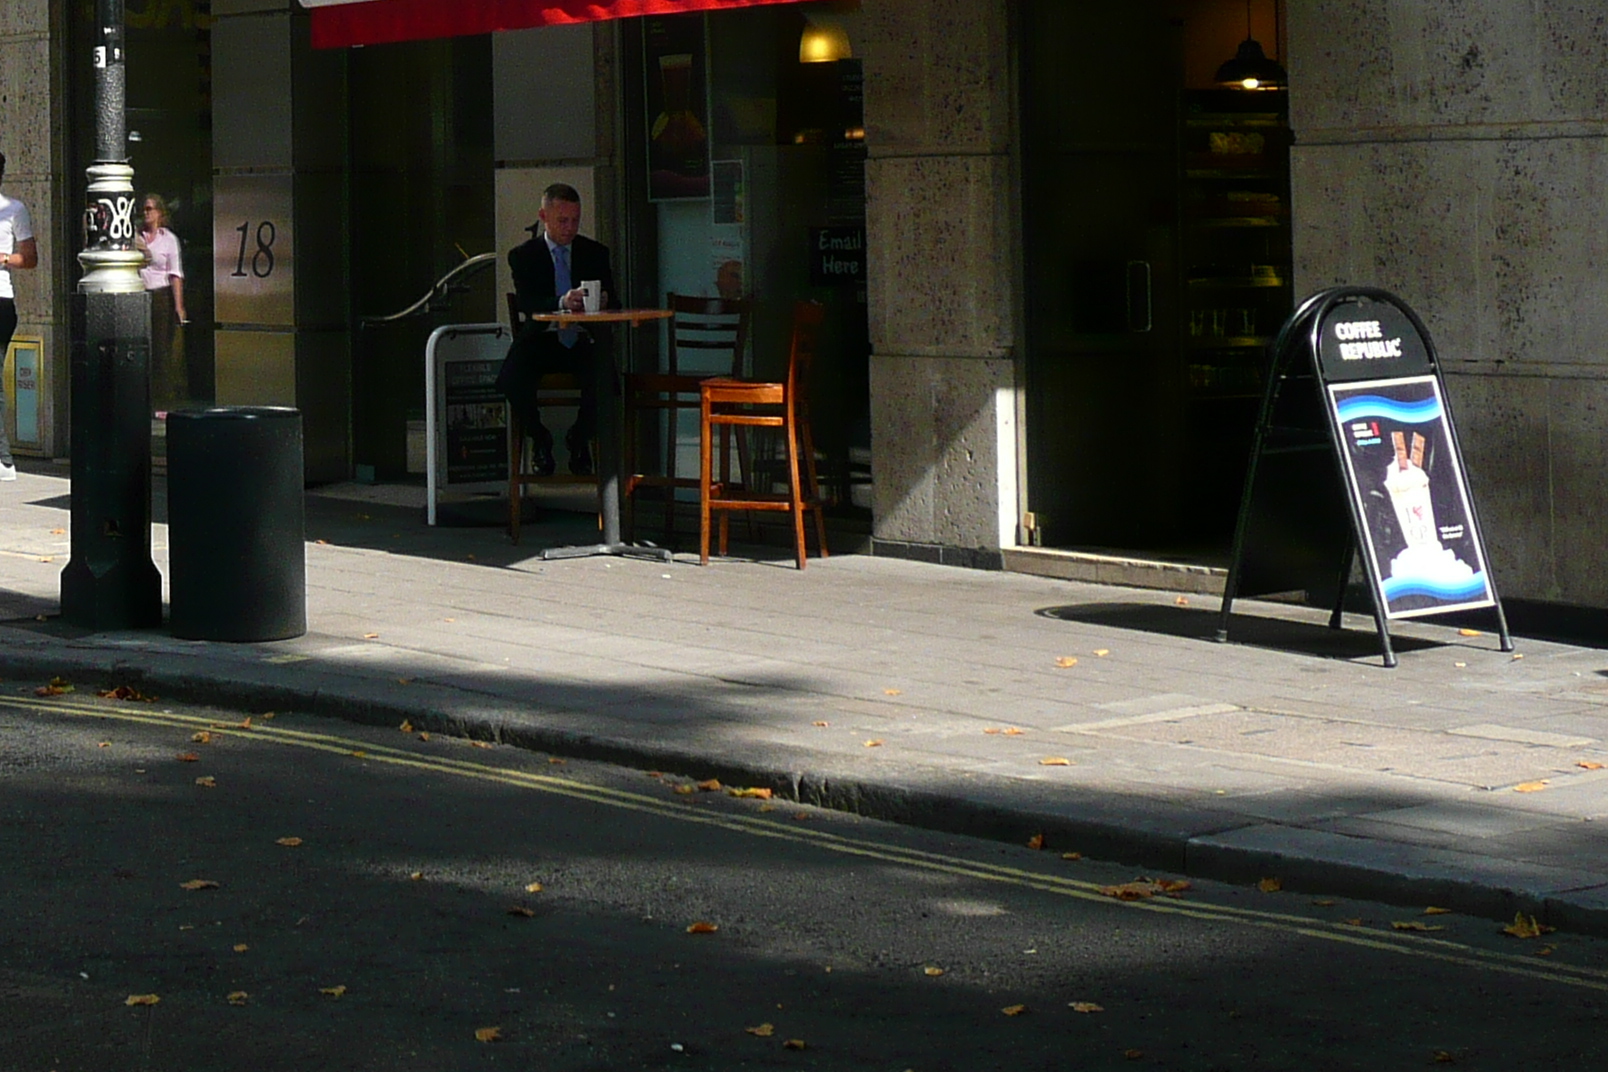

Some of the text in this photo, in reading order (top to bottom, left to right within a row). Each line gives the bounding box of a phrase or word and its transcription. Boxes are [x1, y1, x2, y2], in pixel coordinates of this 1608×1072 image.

[231, 220, 276, 278] 18
[818, 229, 863, 250] Email
[822, 254, 860, 275] Here
[1334, 320, 1383, 341] COFFEE
[1339, 337, 1403, 361] REPUBLIC
